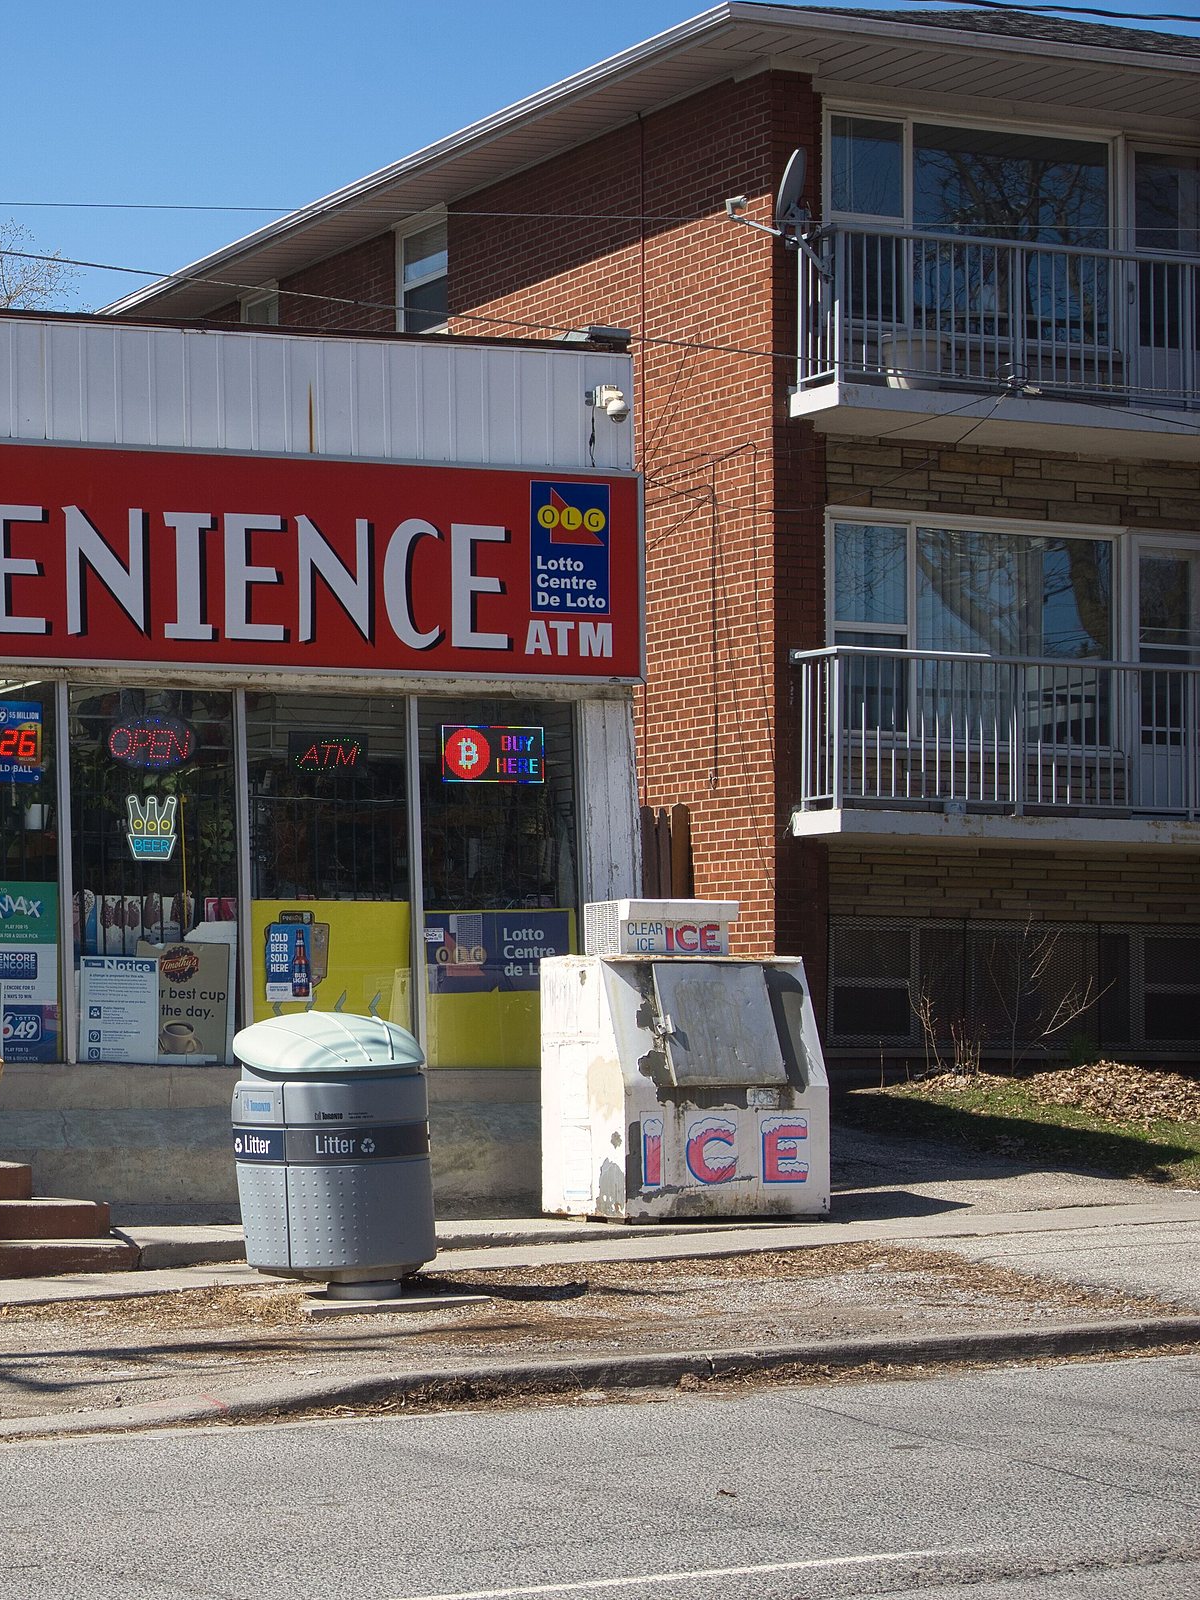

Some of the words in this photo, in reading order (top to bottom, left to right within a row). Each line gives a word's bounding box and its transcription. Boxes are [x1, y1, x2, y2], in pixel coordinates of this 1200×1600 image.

[540, 507, 603, 531] OLG
[537, 556, 584, 571] Lotto
[537, 574, 598, 590] Centre
[537, 592, 560, 606] De
[566, 593, 606, 608] Loto
[525, 620, 613, 657] ATM
[0, 730, 36, 757] 26
[110, 728, 190, 759] OPEN
[502, 736, 534, 751] BUY
[300, 744, 358, 765] ATM
[13, 764, 32, 773] BALL
[496, 758, 538, 774] HERE
[134, 840, 170, 852] BEER
[504, 928, 545, 941] Lotto
[628, 922, 663, 936] CLEAR
[664, 920, 721, 952] ICE
[271, 934, 288, 942] COLD
[637, 938, 656, 950] ICE
[271, 944, 288, 952] BEER
[504, 945, 556, 959] Centre
[161, 955, 197, 971] Timothy's
[271, 954, 288, 962] SOLD
[105, 960, 150, 972] Notice
[271, 964, 288, 972] HERE
[504, 962, 523, 976] de
[170, 988, 196, 999] best
[200, 992, 226, 1003] cup
[161, 1004, 182, 1016] the
[186, 1006, 214, 1020] day.
[3, 1016, 38, 1038] 649
[322, 1112, 343, 1120] TORONTO
[245, 1134, 270, 1154] Litter
[315, 1135, 356, 1154] Litter
[643, 1117, 809, 1186] ICE
